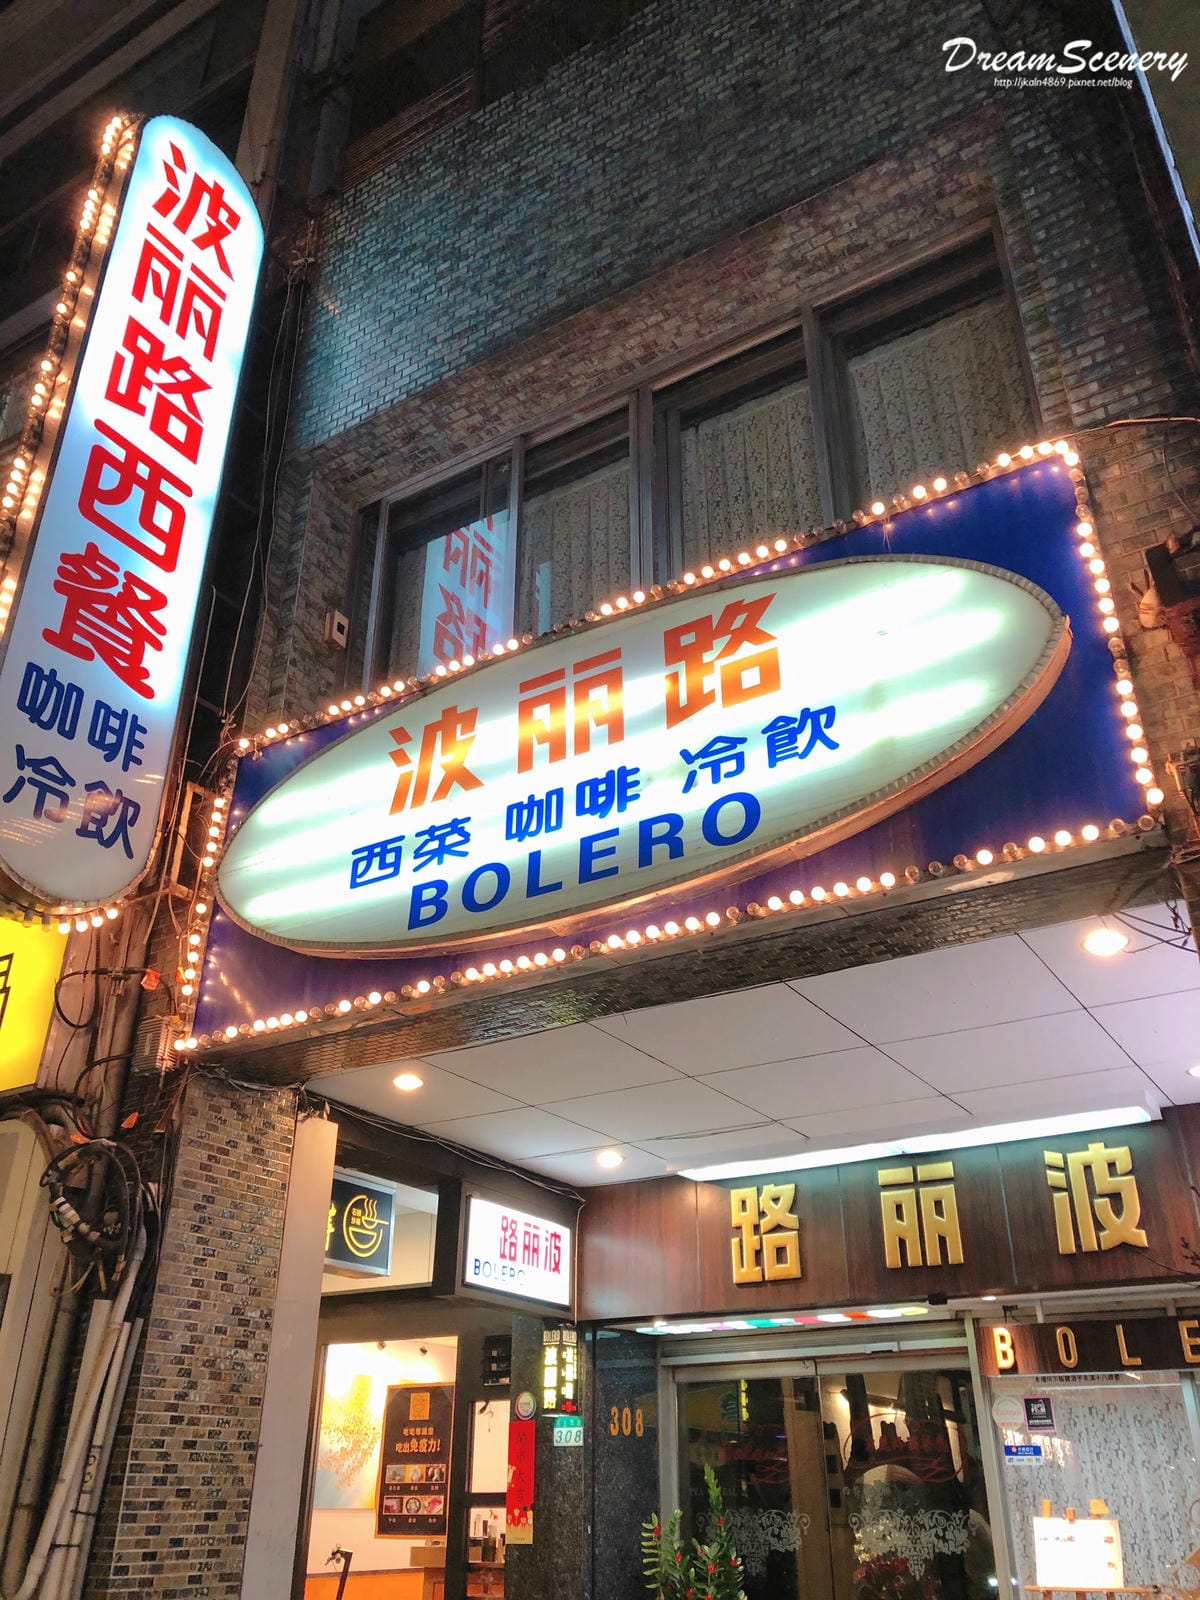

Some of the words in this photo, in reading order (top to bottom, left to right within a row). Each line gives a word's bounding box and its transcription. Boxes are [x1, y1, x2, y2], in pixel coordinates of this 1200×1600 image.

[16, 661, 148, 772] 咖啡
[2, 744, 141, 860] 冷飲
[350, 816, 471, 889] 西菜
[506, 766, 640, 842] 咖啡
[680, 705, 840, 793] 冷飲
[407, 792, 762, 931] BOLERO
[992, 1320, 1200, 1370] BOLE
[555, 1430, 582, 1444] 308
[610, 1406, 644, 1437] 308
